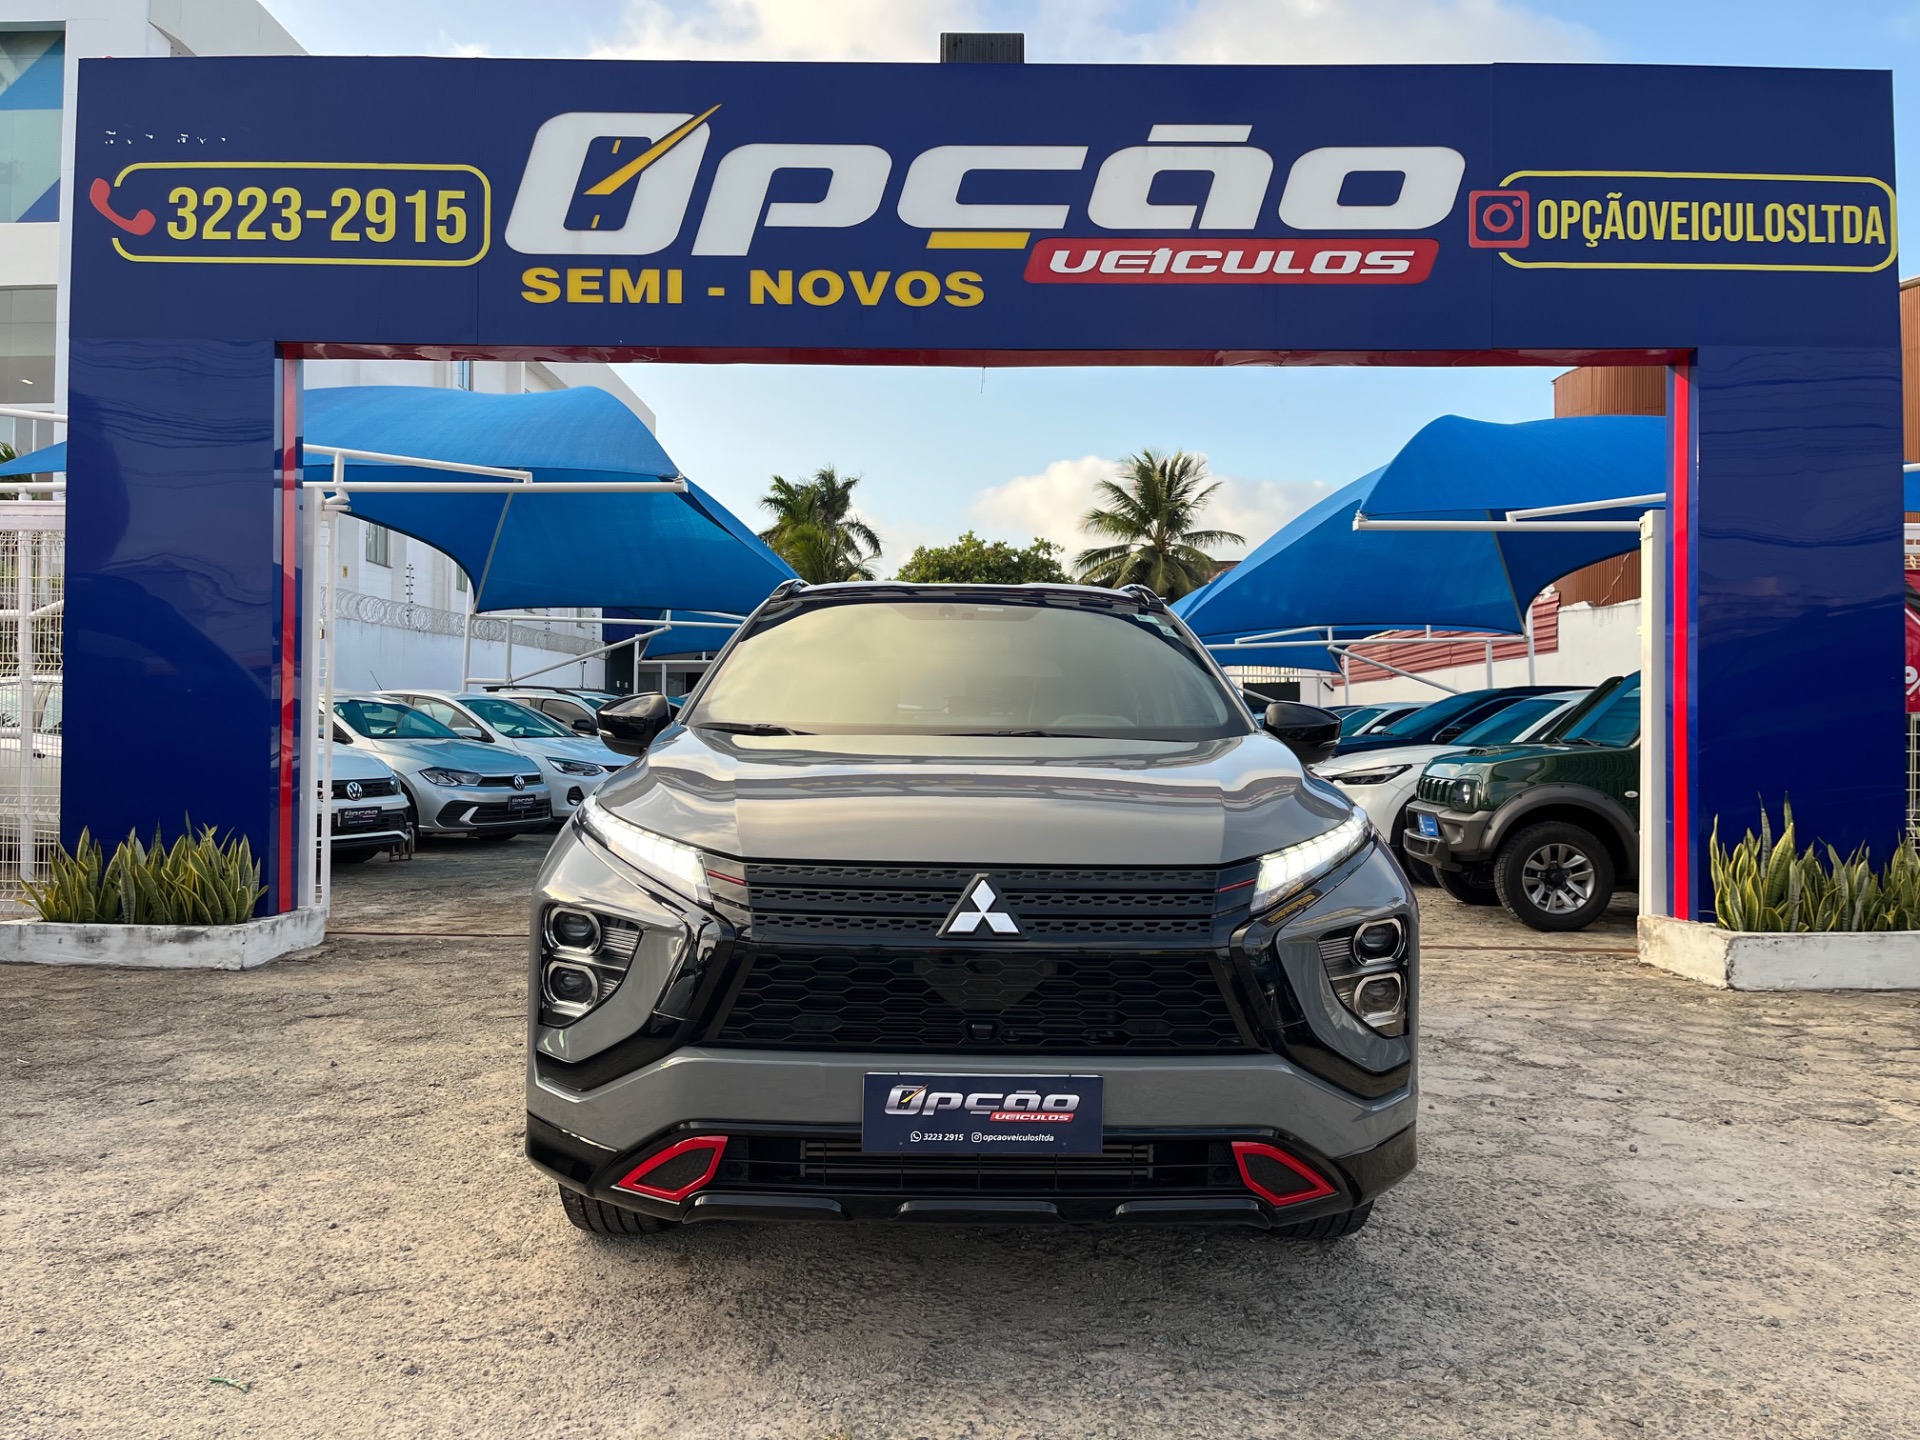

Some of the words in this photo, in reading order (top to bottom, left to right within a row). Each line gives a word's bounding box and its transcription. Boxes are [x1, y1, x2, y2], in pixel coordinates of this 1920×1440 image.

[167, 186, 467, 244] 3223-2915
[1537, 191, 1886, 247] OPÇÃOVEICULOSLTDA
[521, 267, 683, 303] SEMI
[750, 269, 985, 307] NOVOS
[922, 1133, 942, 1141] 3223
[943, 1133, 964, 1141] 2915
[982, 1133, 1054, 1142] opcaoveiculosltda
